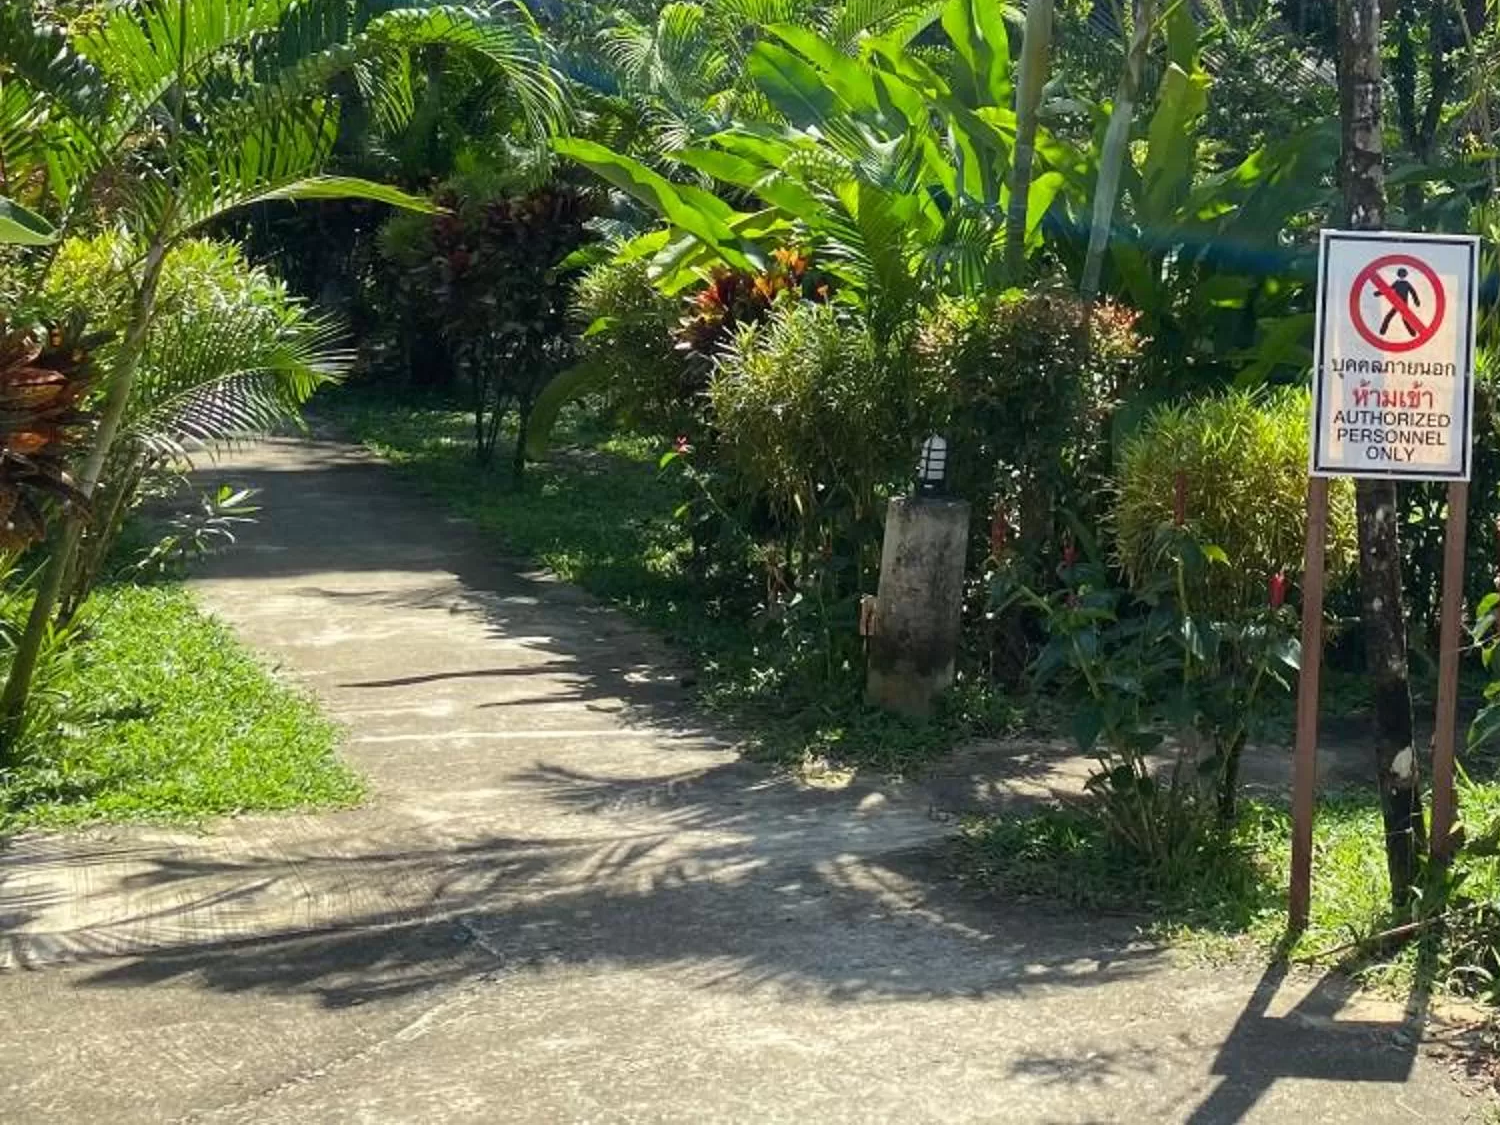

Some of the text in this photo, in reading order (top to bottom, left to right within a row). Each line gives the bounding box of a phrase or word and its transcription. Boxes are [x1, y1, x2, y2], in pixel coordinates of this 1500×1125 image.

[1332, 358, 1456, 379] บุคคลภายนอก
[1352, 379, 1433, 409] ห้ามเข้า
[1334, 410, 1450, 427] AUTHORIZED
[1337, 428, 1446, 446] PERSONNEL
[1366, 447, 1415, 462] ONLY
